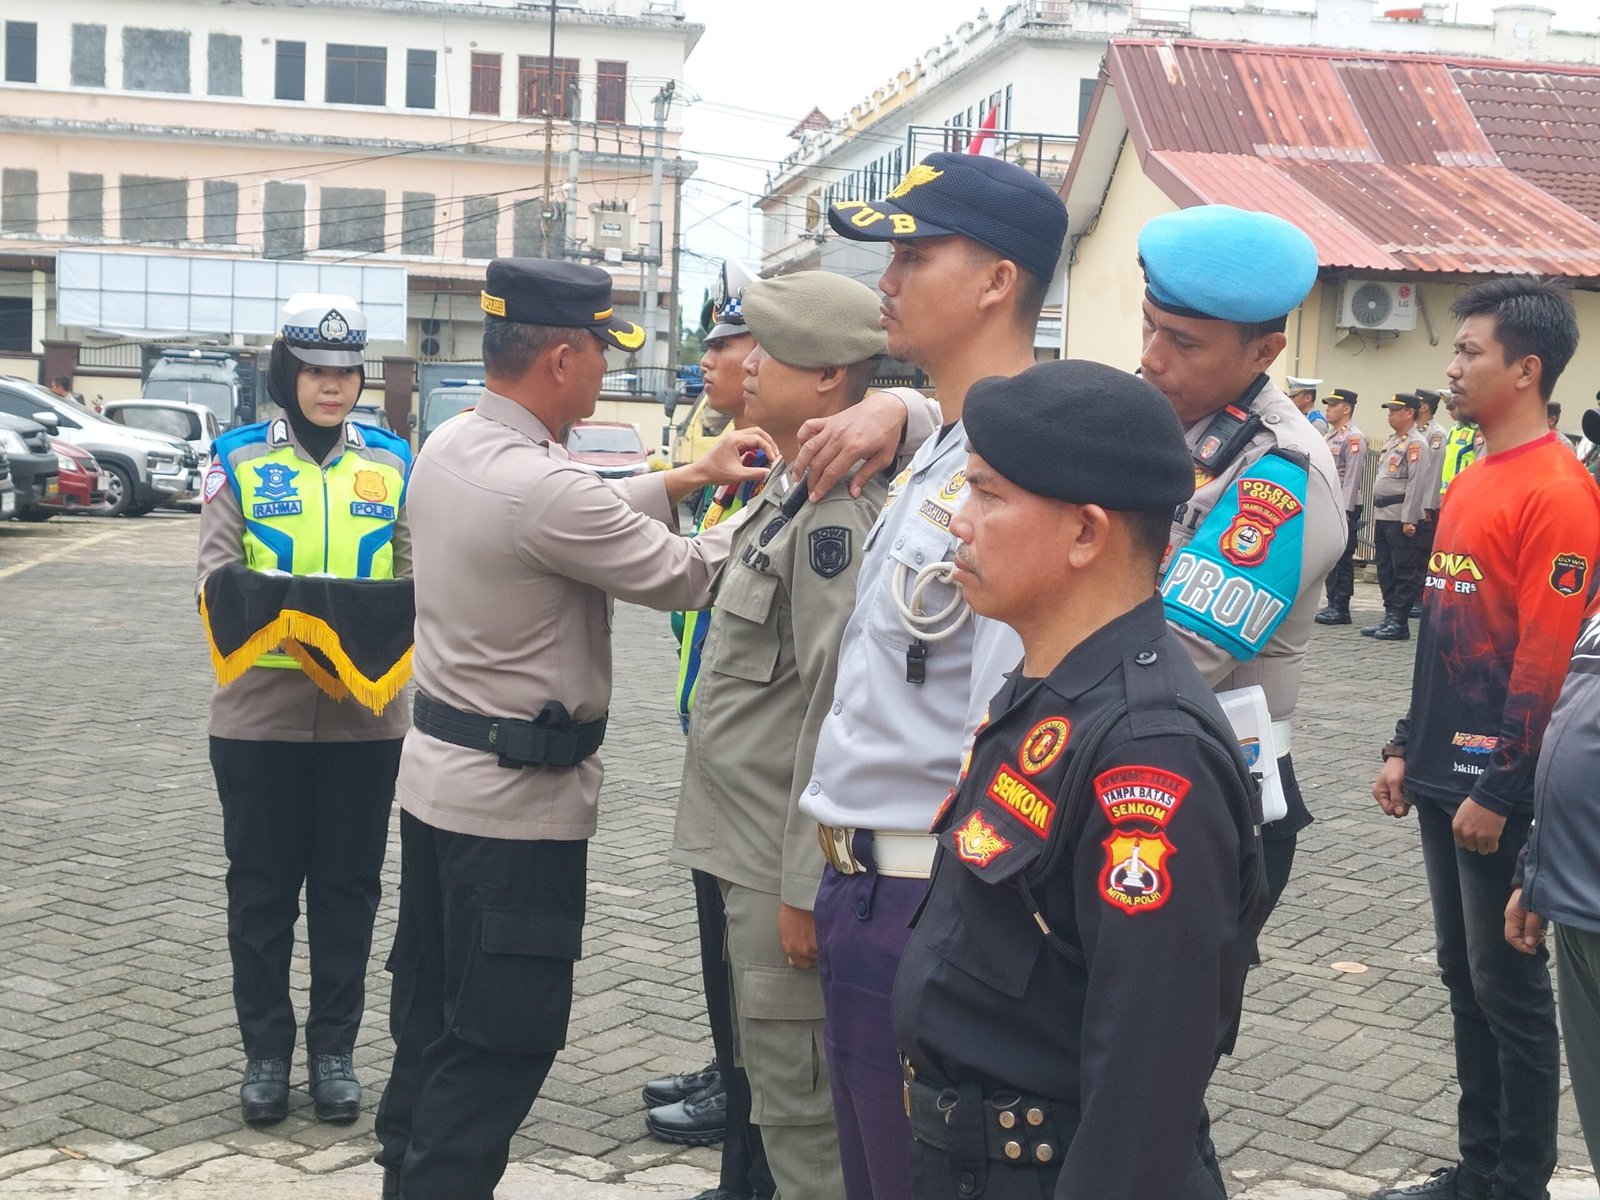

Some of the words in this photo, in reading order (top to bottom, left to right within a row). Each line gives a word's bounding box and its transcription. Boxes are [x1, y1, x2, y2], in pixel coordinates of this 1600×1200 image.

[1243, 481, 1298, 510] POLRES
[1250, 489, 1285, 511] GOWA
[256, 502, 299, 516] RAHMA
[354, 504, 393, 519] POLRI
[920, 501, 950, 526] DISHUB
[1557, 557, 1586, 567] GOWA
[1162, 552, 1286, 645] PROV
[993, 773, 1048, 829] SENKOM
[1104, 787, 1136, 804] TANPA
[1139, 787, 1173, 806] BATAS
[1112, 802, 1166, 821] SENKOM
[1106, 886, 1132, 905] MITRA
[1133, 891, 1161, 906] POLRI
